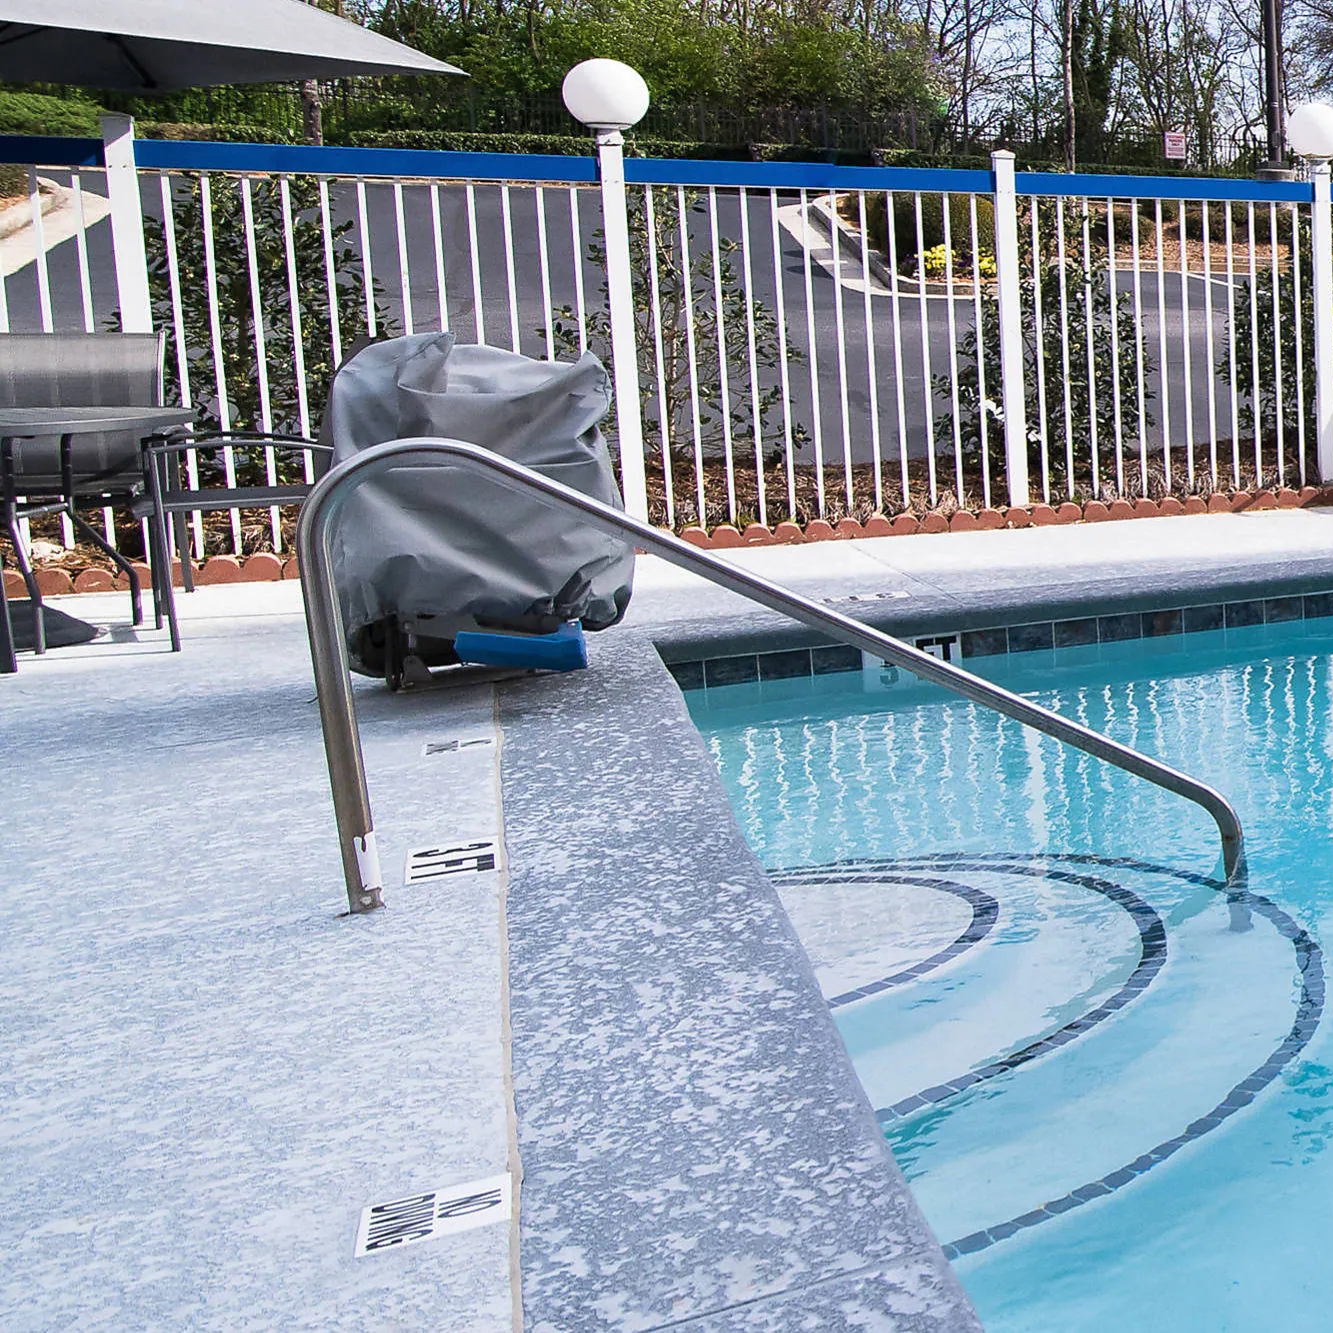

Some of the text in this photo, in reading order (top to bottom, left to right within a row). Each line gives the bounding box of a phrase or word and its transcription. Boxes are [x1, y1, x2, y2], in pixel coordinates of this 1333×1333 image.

[410, 853, 495, 880] FT
[437, 1188, 502, 1218] NO
[366, 1193, 436, 1251] DIVING
